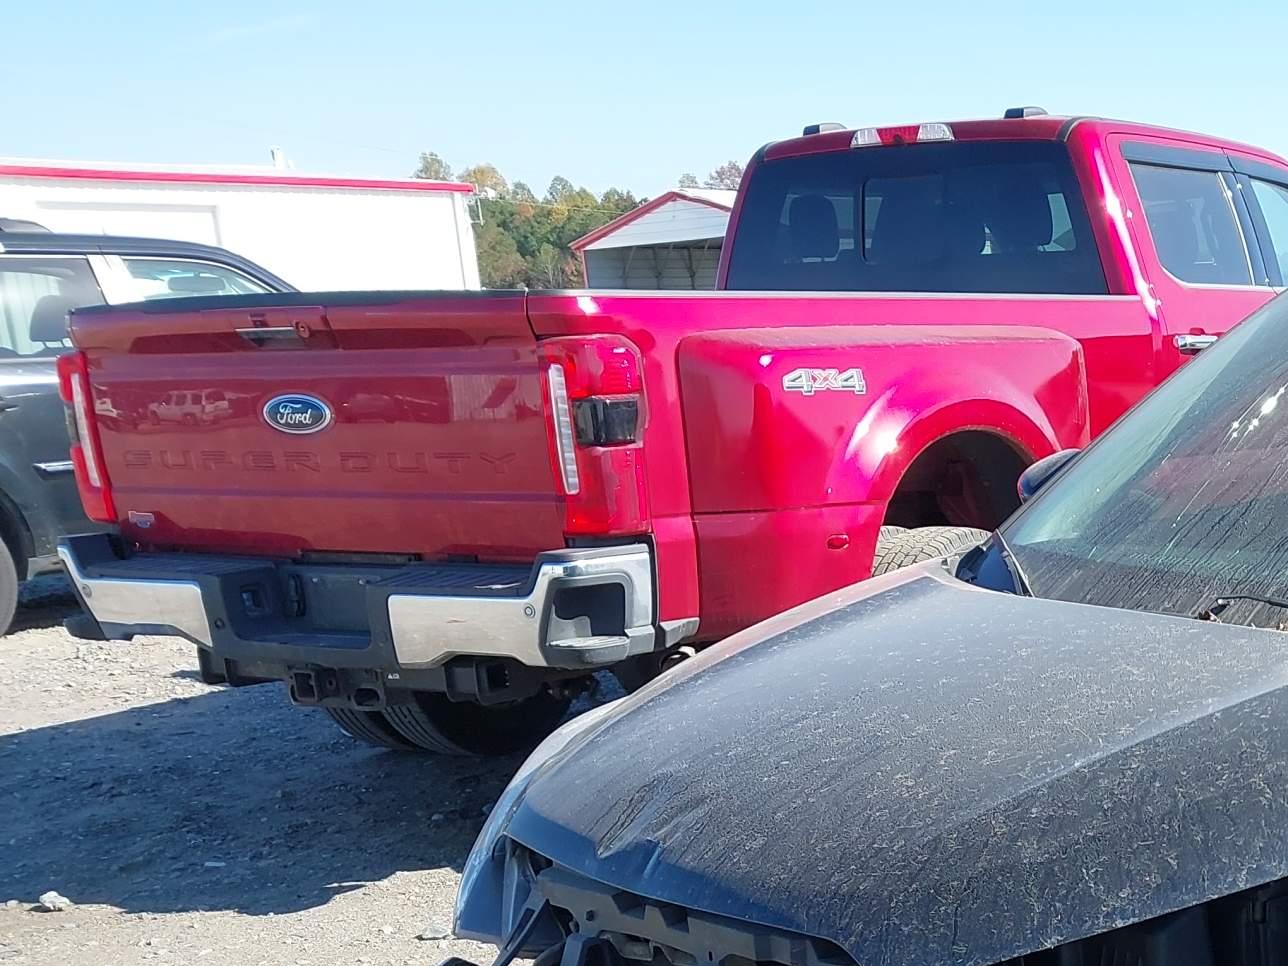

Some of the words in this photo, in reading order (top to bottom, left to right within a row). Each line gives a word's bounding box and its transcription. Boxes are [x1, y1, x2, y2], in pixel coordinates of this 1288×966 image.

[277, 402, 313, 424] Ford
[123, 449, 321, 473] SUPER
[340, 451, 518, 475] DUTY
